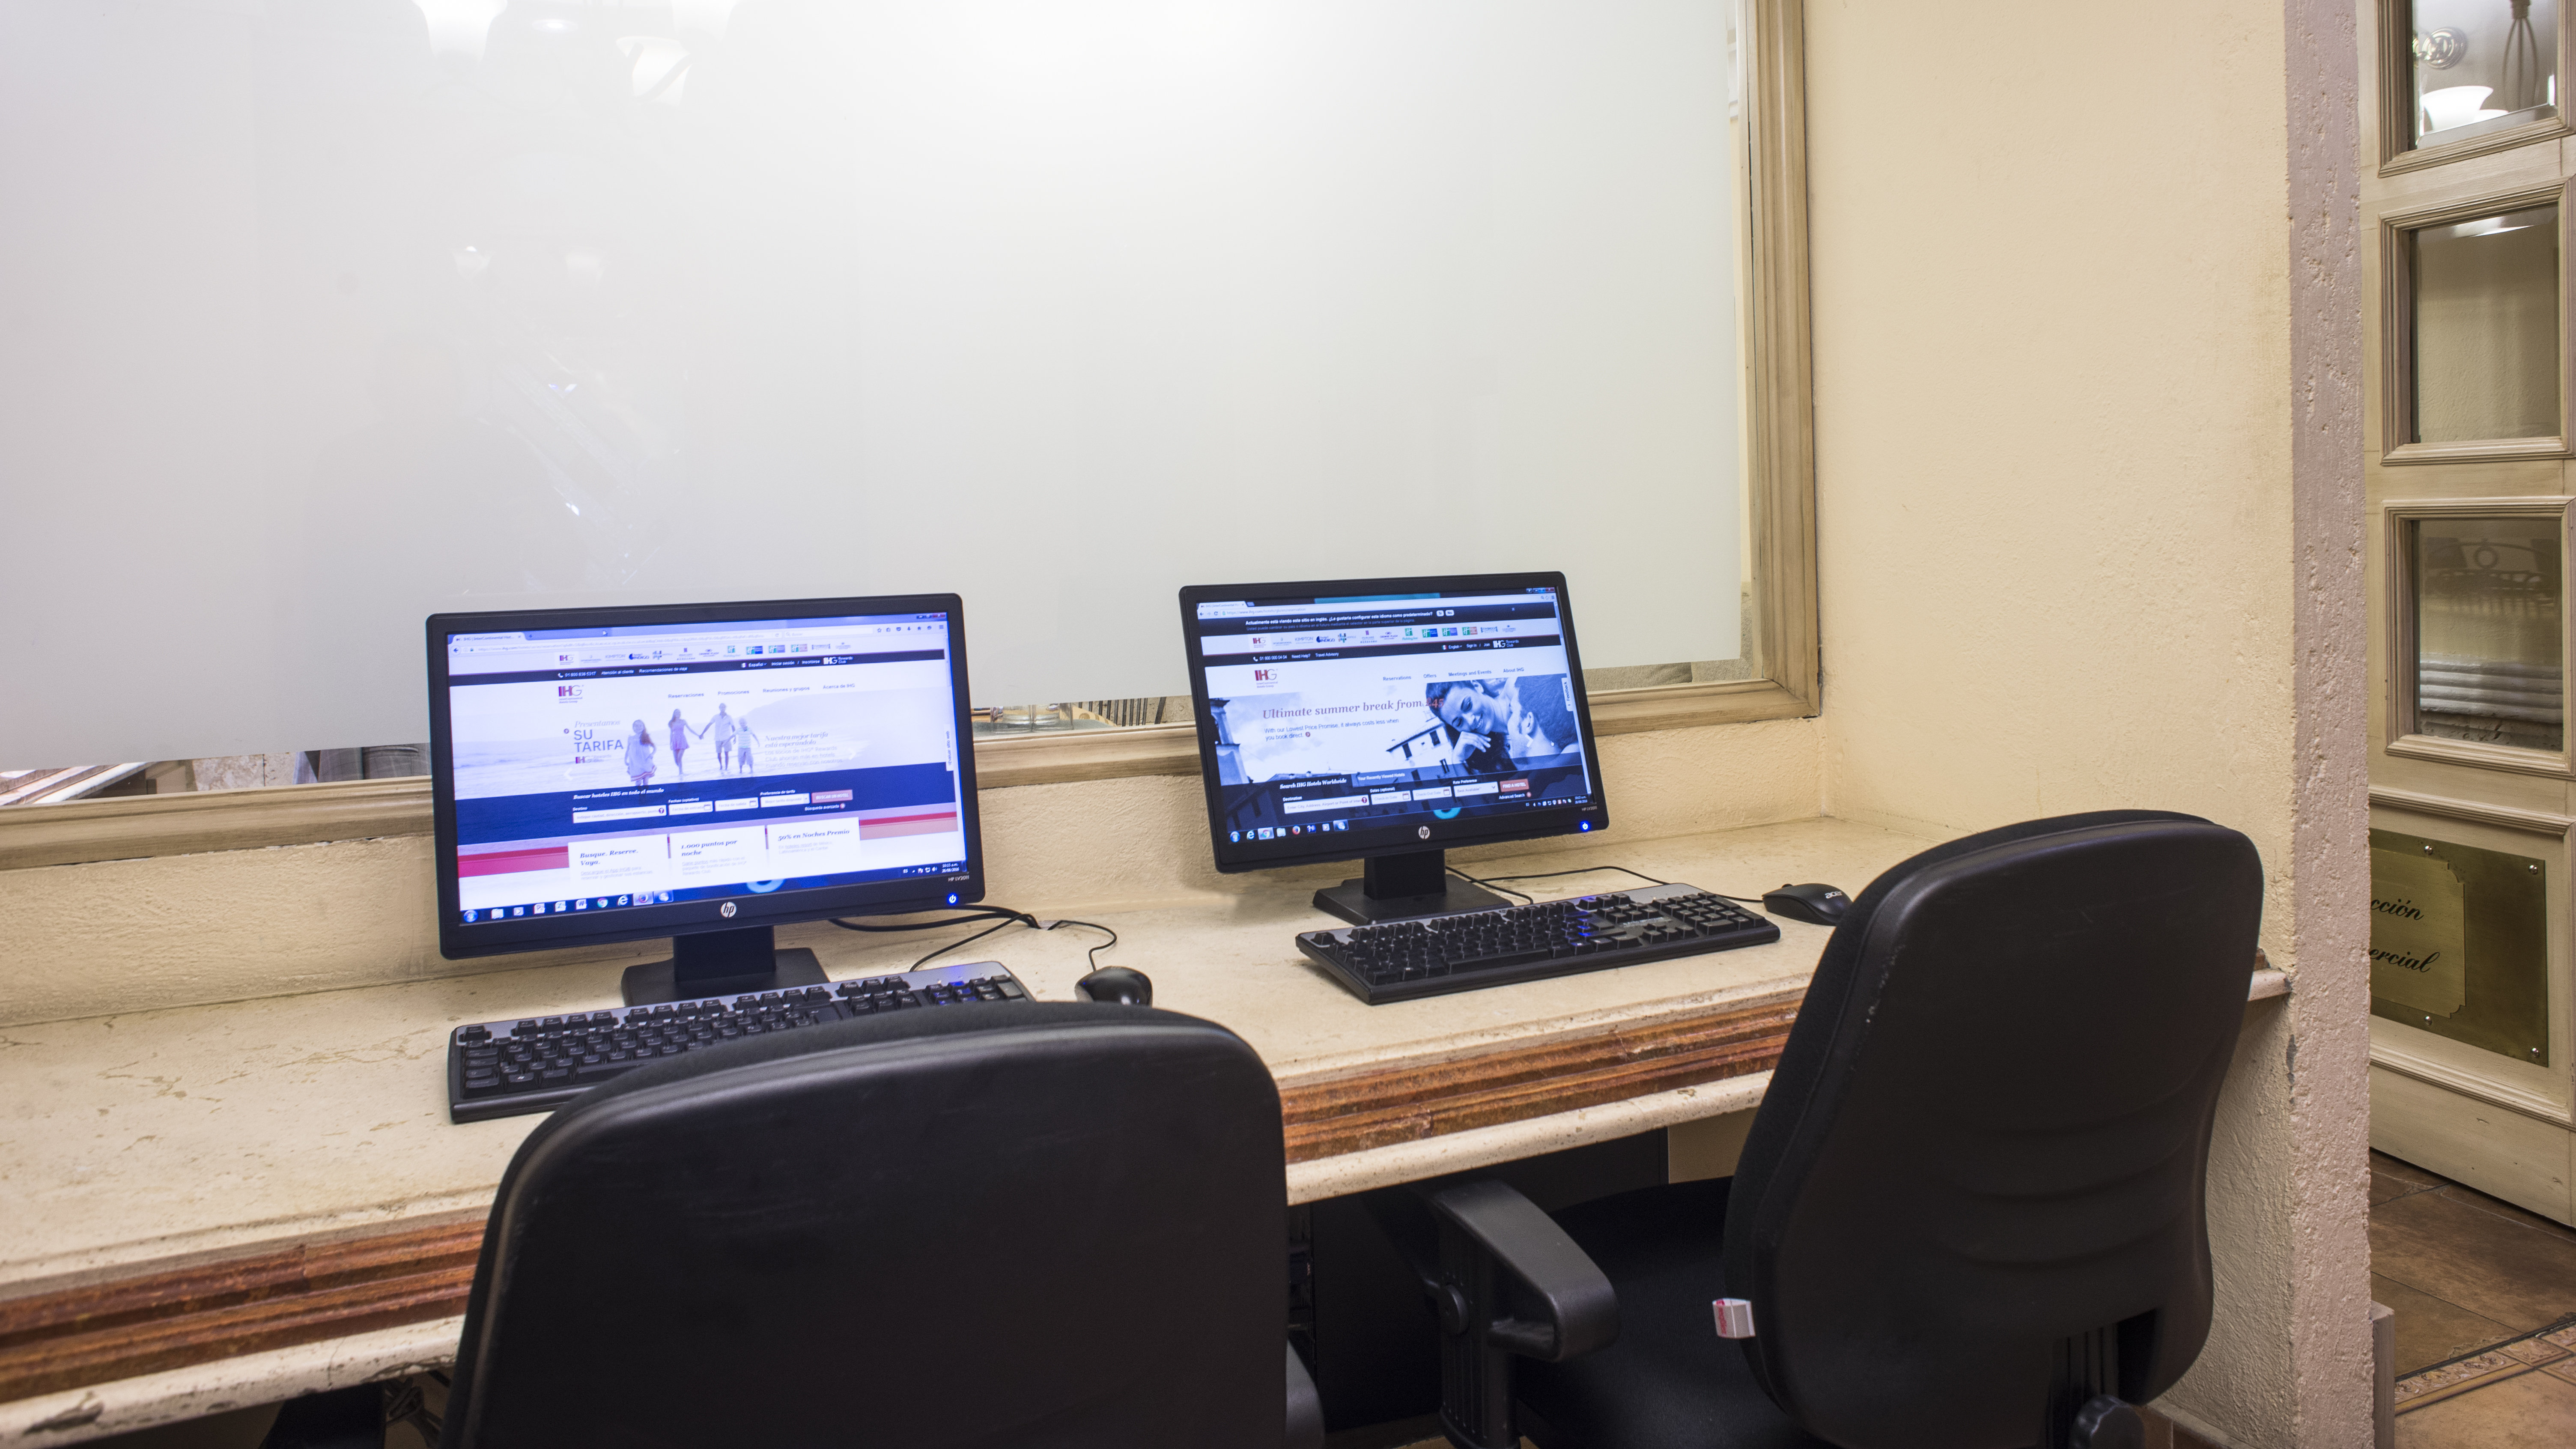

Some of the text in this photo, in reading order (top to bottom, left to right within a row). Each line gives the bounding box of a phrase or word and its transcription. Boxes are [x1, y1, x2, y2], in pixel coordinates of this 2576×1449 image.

[1493, 640, 1506, 648] IHG
[1255, 669, 1277, 681] IHG
[558, 685, 582, 697] IHG
[1263, 698, 1444, 719] Ultimate summer break from £45
[573, 729, 593, 740] SU
[573, 739, 624, 753] TARIFA
[779, 739, 816, 748] esperándolo
